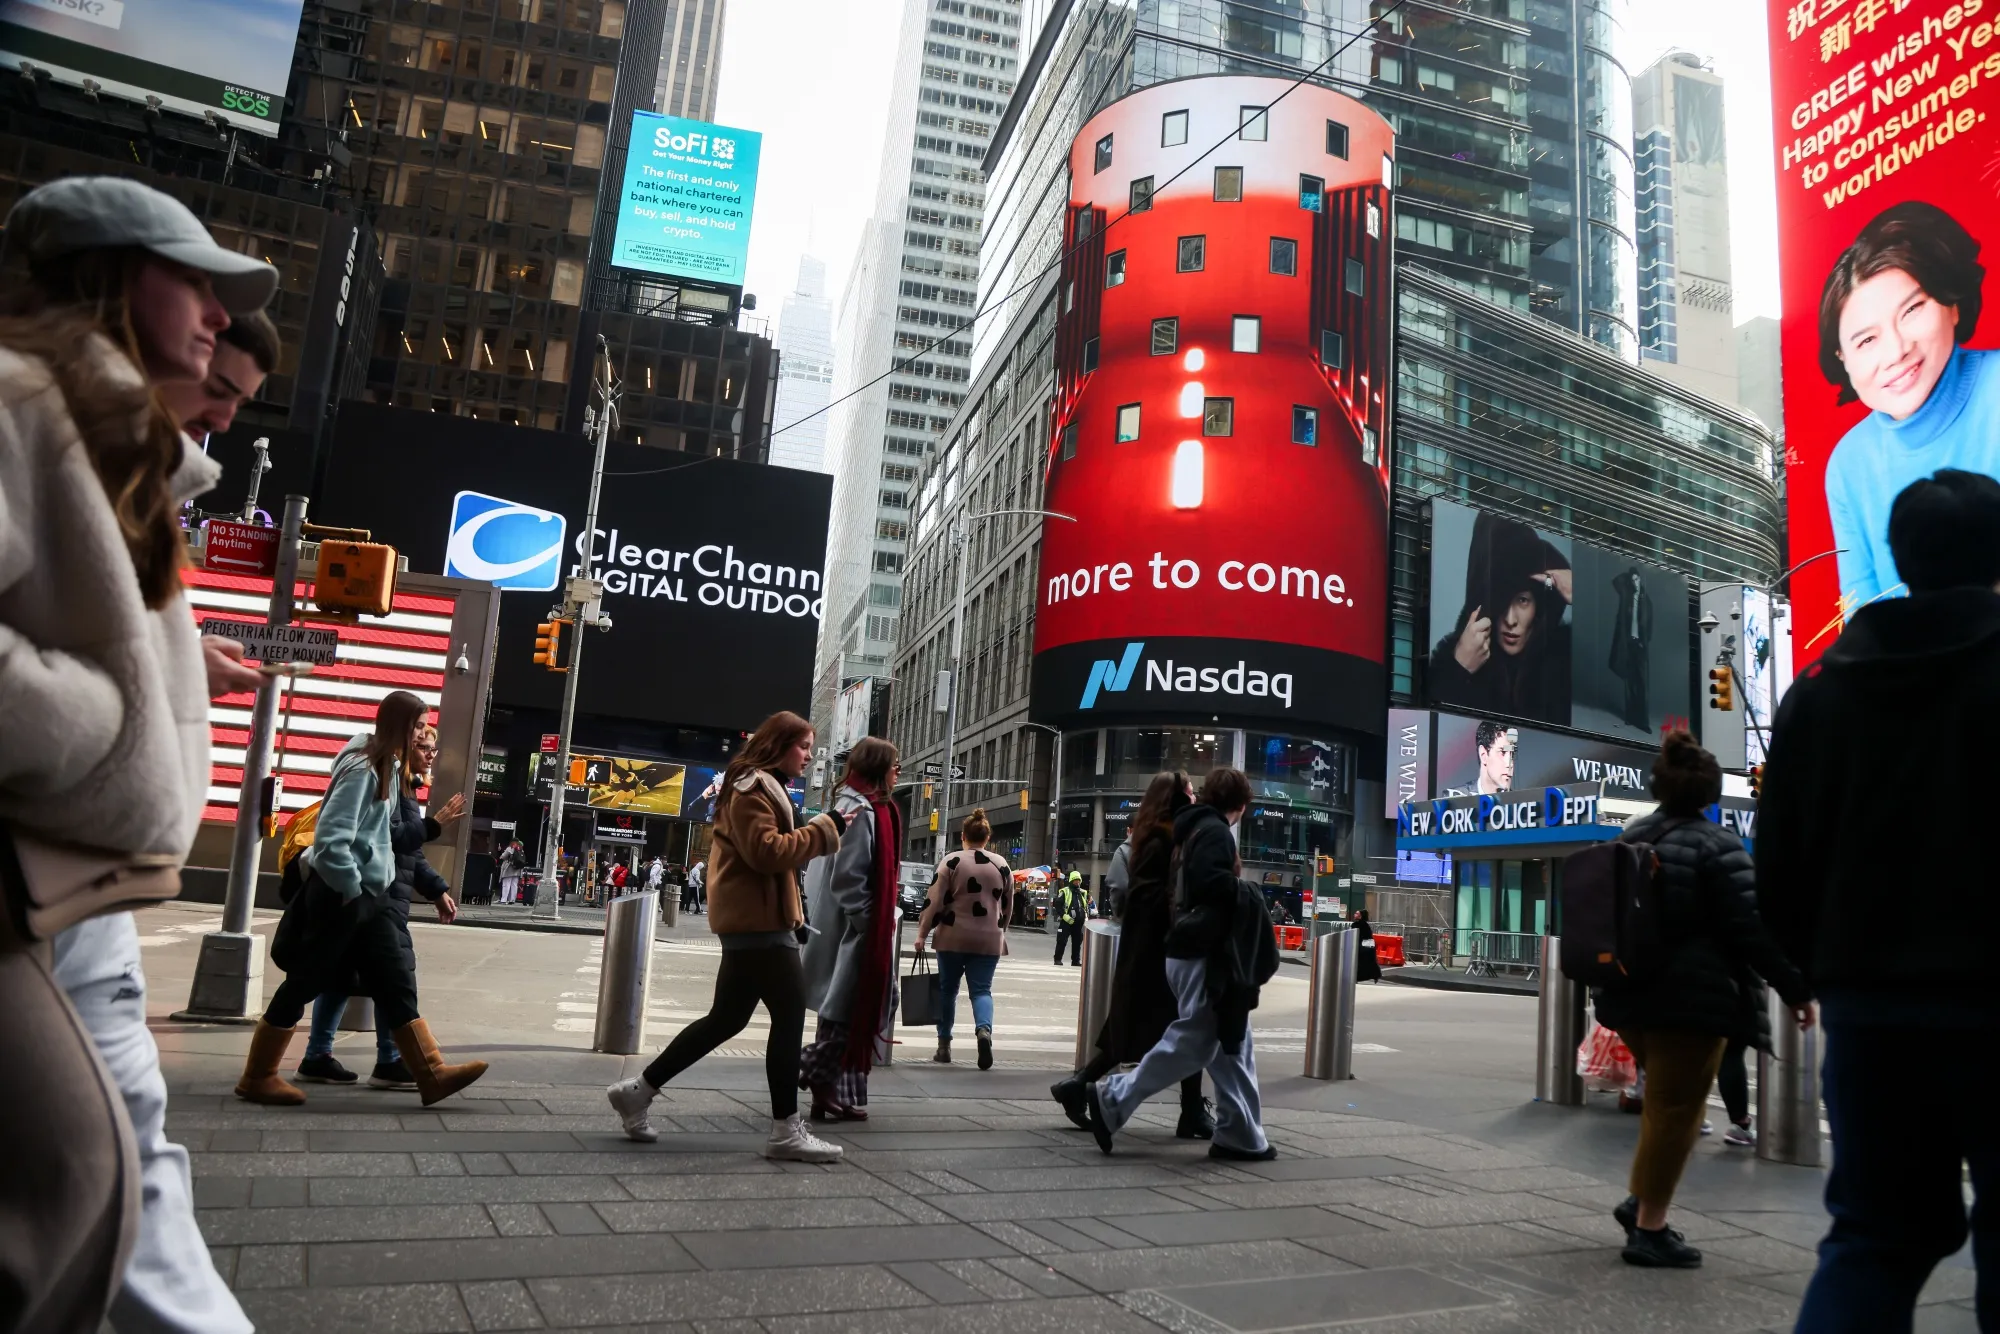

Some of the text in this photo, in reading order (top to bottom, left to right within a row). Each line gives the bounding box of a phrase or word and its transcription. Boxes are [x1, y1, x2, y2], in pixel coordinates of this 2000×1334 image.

[1791, 0, 1983, 130] GREE wishes
[224, 84, 271, 102] DETECT THE
[1783, 101, 1866, 170] Happy
[1872, 54, 1940, 114] New
[654, 128, 708, 155] SoFi
[652, 150, 732, 170] Get Your Money Right
[1823, 107, 1986, 209] worldwide.
[642, 165, 740, 192] The first and only
[1802, 161, 1829, 190] to
[630, 192, 743, 218] bank where you can
[636, 180, 741, 204] national chartered
[634, 205, 736, 231] buy, sell, and hold
[664, 226, 704, 240] crypto.
[636, 244, 672, 255] INVESTMENTS
[666, 254, 688, 262] INSURED
[211, 536, 252, 550] Anytime
[212, 524, 277, 542] NO STANDING
[1048, 551, 1354, 608] more to come.
[204, 620, 336, 646] PEDESTRIAN FLOW ZONE
[262, 645, 333, 664] KEEP MOVING
[1146, 659, 1292, 708] Nasdaq
[1401, 724, 1417, 756] WE
[1572, 757, 1645, 790] WE WIN.
[1398, 788, 1597, 837] NEW YORK POLICE DEPT
